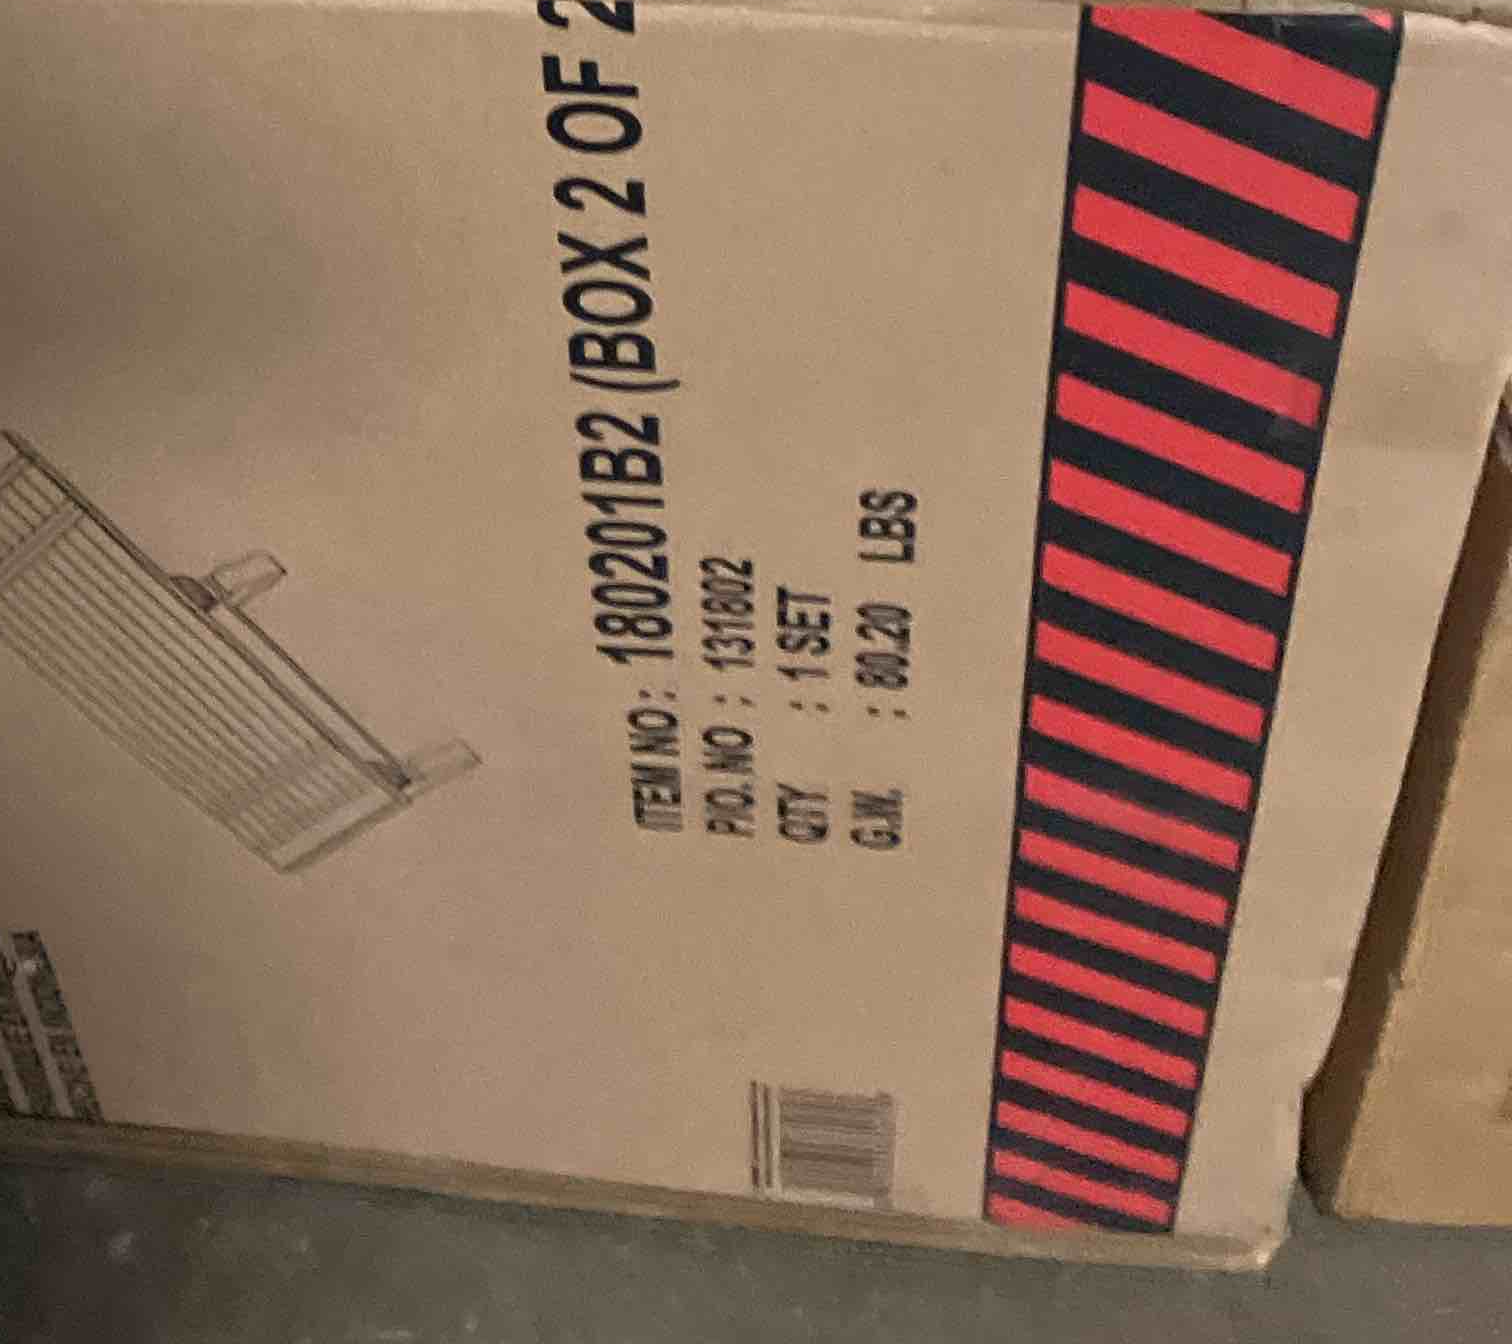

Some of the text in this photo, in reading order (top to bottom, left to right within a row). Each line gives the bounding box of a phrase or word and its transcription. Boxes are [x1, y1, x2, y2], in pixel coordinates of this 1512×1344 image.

[542, 54, 644, 153] OF
[553, 177, 647, 215] 2
[556, 230, 681, 394] (BOX
[574, 408, 676, 666] 180201B2
[858, 488, 918, 563] LBS
[776, 585, 832, 655] SET
[777, 665, 830, 681] 1
[701, 726, 754, 775] NO
[630, 762, 683, 833] ITEM
[777, 783, 830, 844] QTY
